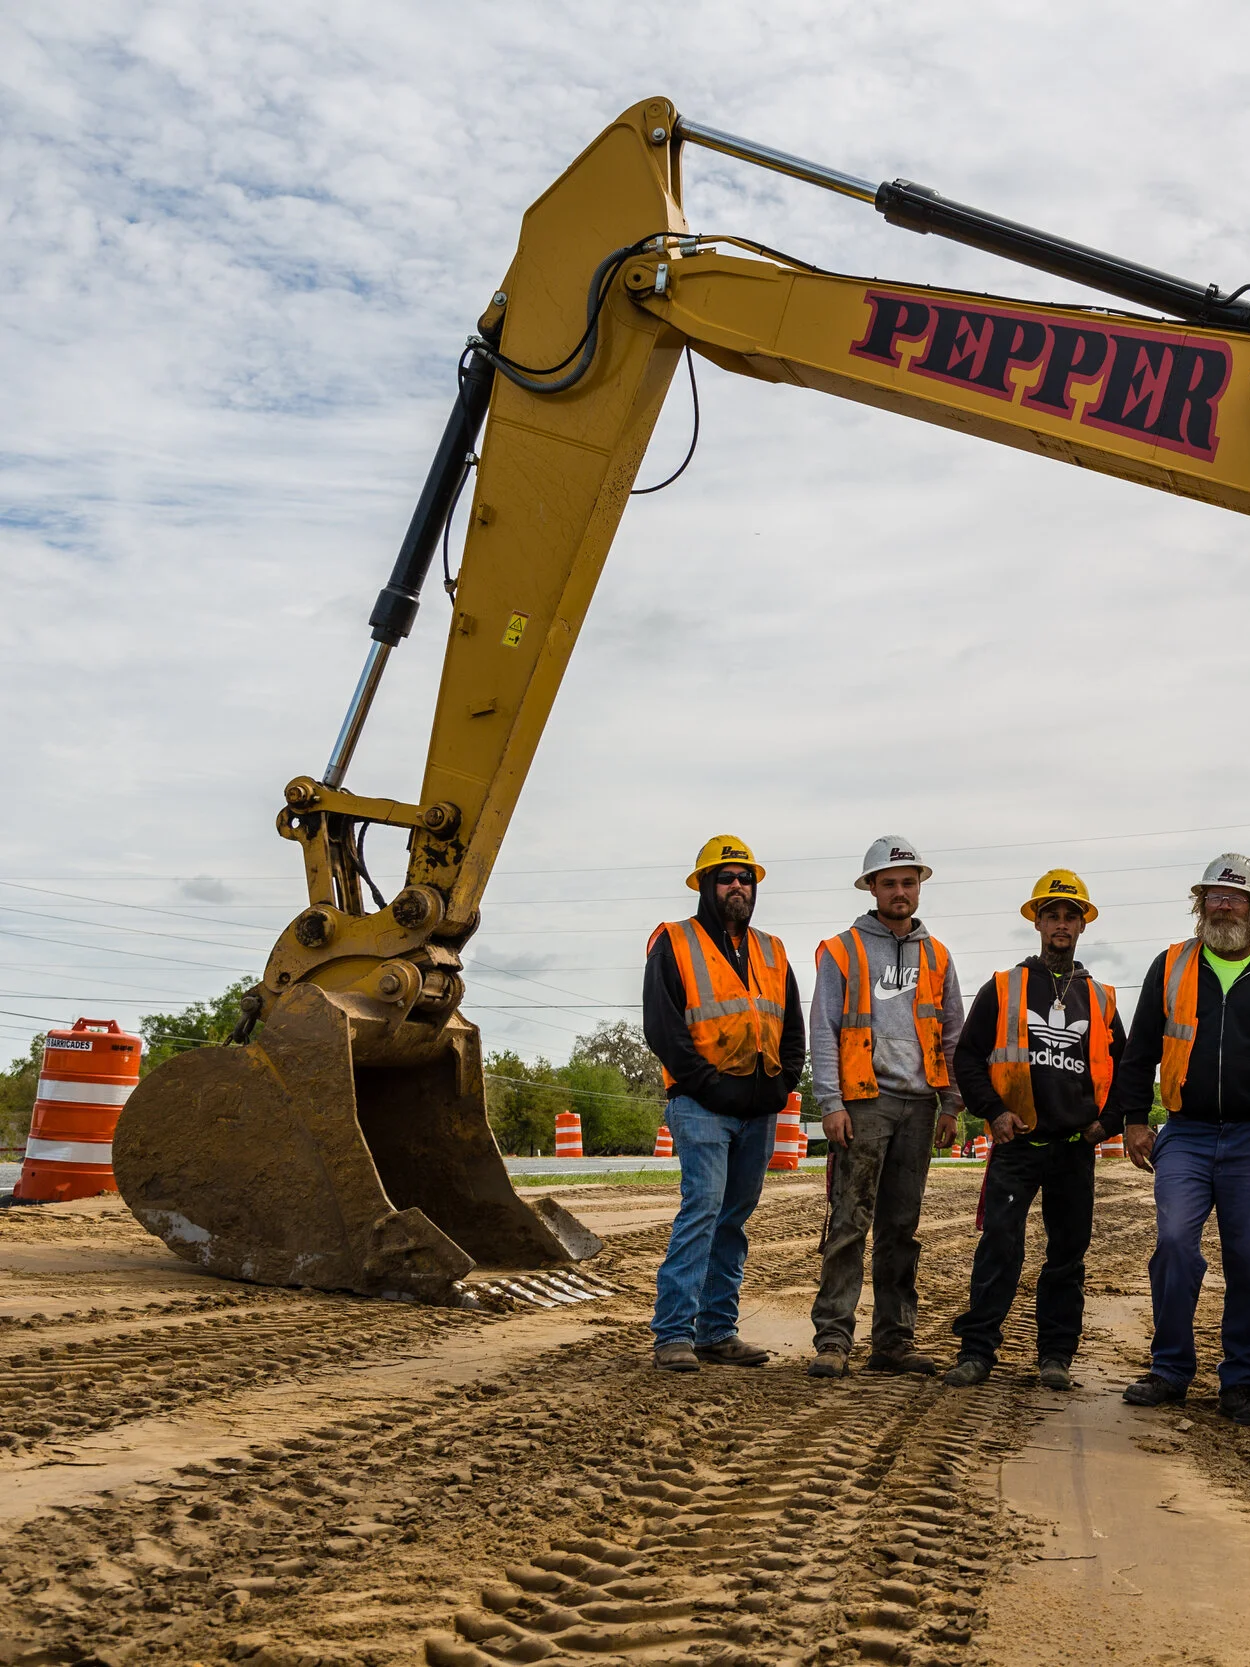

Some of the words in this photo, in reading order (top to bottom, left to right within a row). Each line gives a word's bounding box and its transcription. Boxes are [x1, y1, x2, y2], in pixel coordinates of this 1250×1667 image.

[850, 290, 1232, 462] PEPPER
[883, 965, 920, 985] NIKE
[1029, 1047, 1085, 1074] adidas
